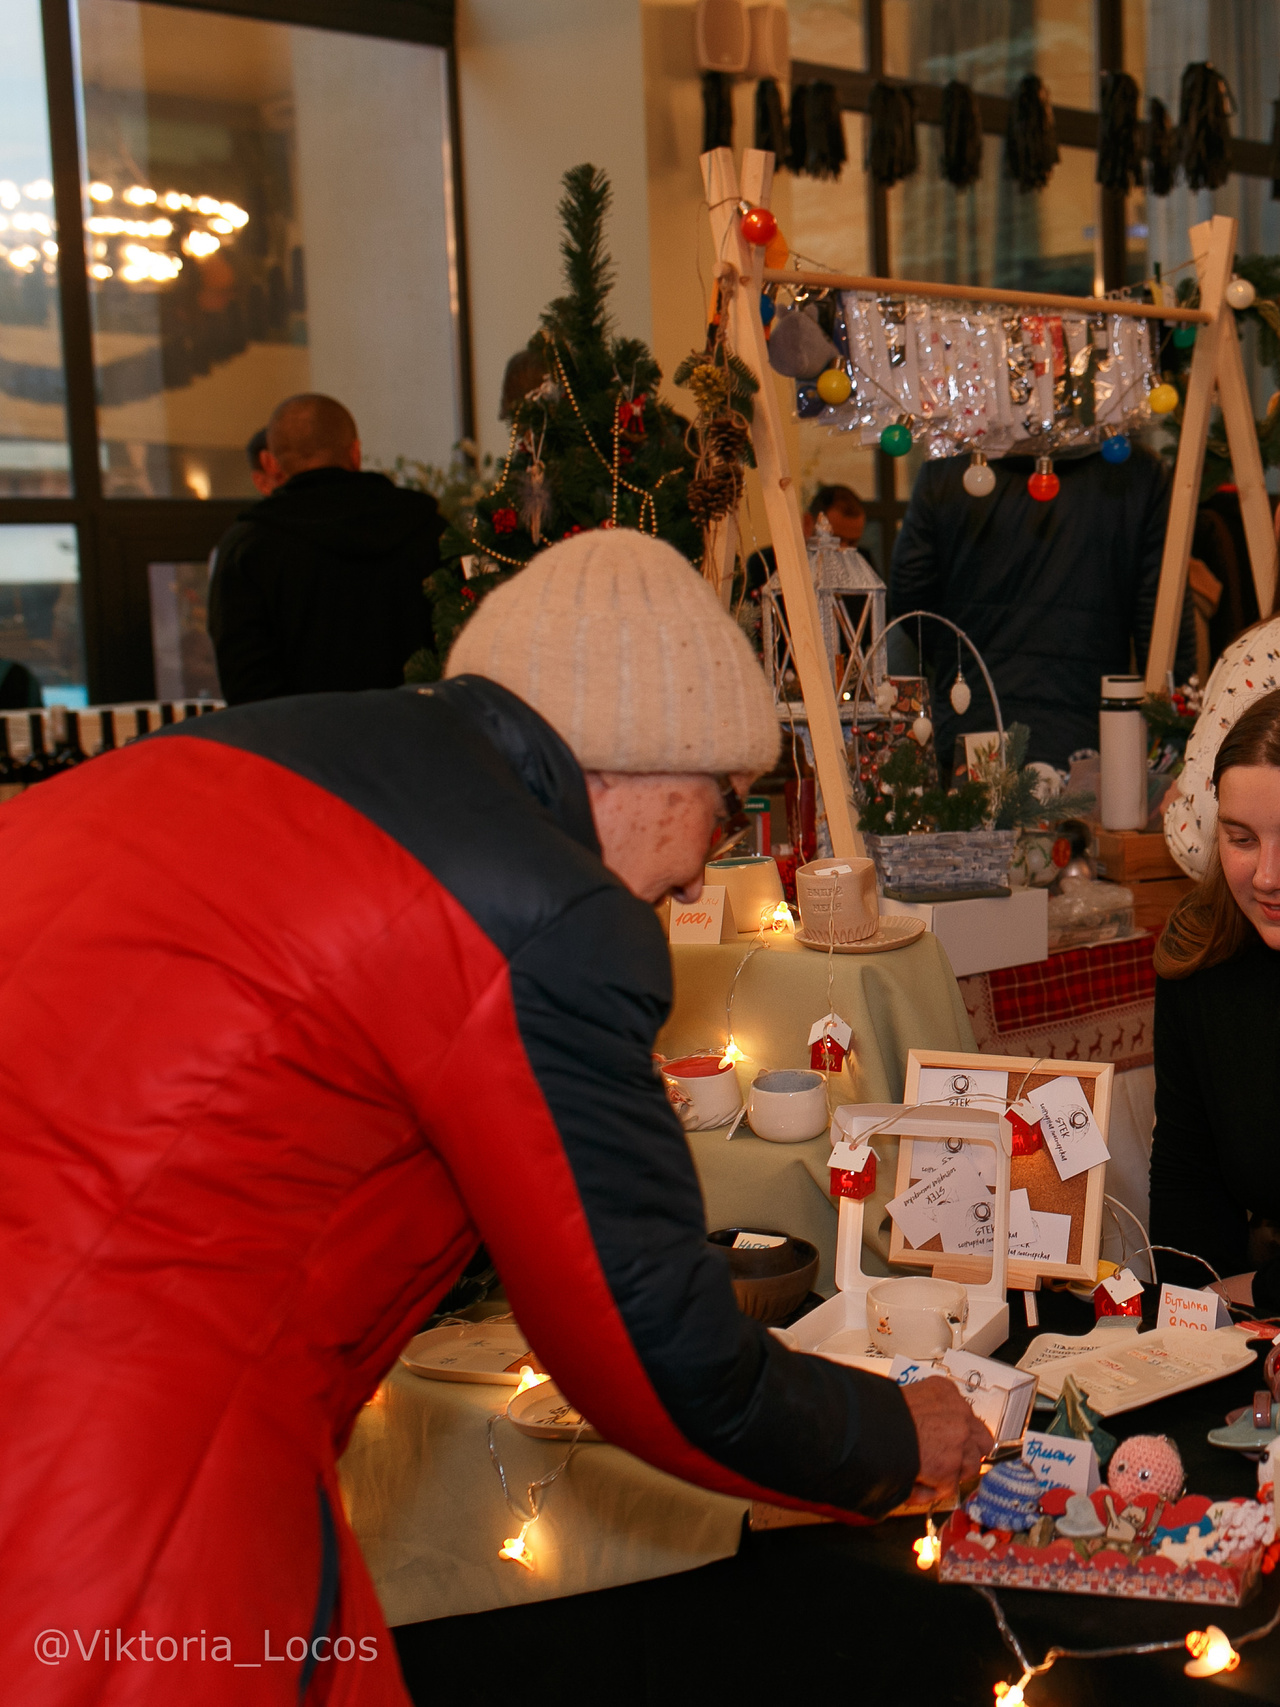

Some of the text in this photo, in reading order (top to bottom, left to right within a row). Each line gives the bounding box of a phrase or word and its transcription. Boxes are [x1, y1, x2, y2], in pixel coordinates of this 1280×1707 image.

[675, 912, 712, 929] 1000р
[948, 1098, 971, 1108] STEK
[1055, 1116, 1070, 1139] STEK
[925, 1186, 946, 1205] STEK
[1165, 1291, 1209, 1314] Бутылка
